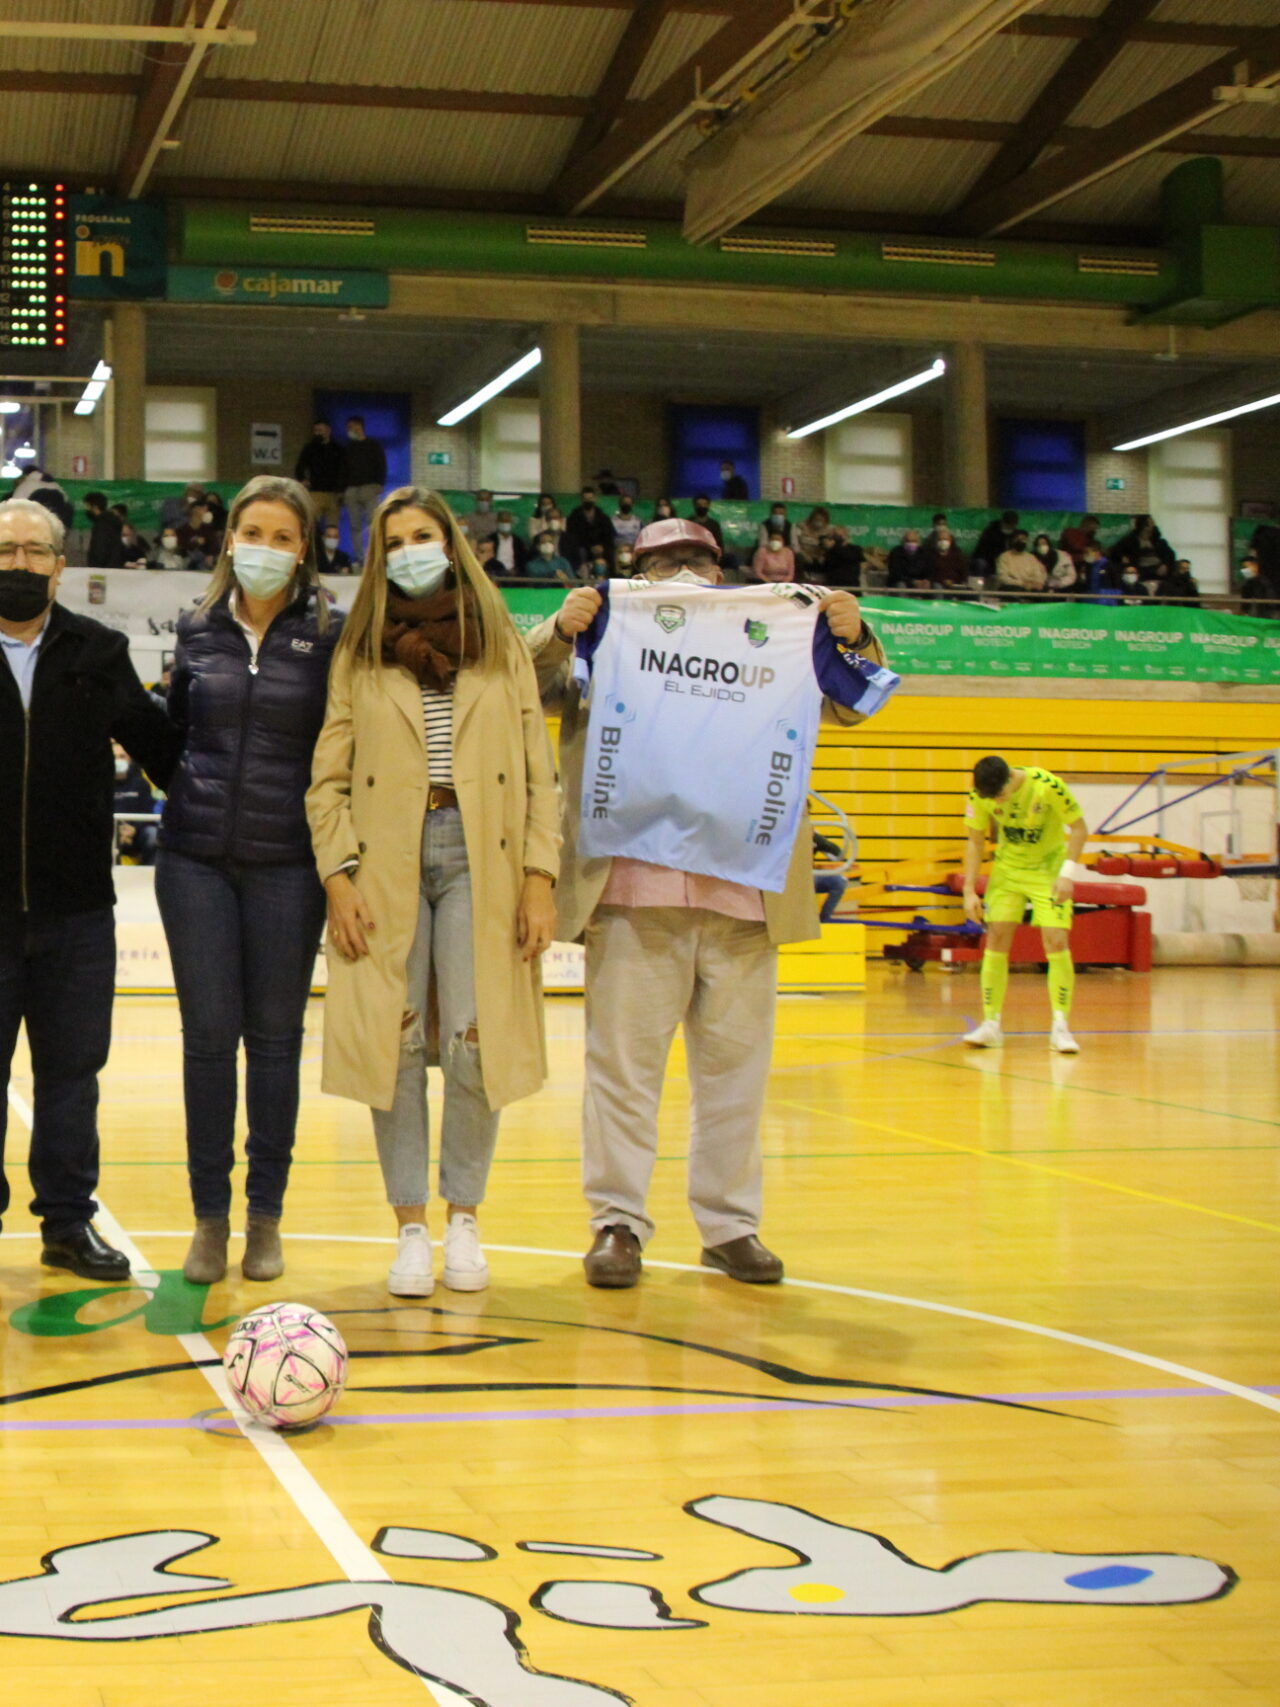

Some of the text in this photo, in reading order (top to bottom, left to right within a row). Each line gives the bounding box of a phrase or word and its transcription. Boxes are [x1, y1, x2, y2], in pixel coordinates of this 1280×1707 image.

[243, 272, 343, 298] cajamar
[882, 623, 953, 636] INAGROUP
[960, 625, 1032, 638] INAGROUP
[1039, 628, 1108, 641] INAGROUP
[1115, 630, 1184, 643] INAGROUP
[291, 638, 314, 652] EA7
[1190, 633, 1258, 647] INAGROUP
[640, 648, 775, 689] INAGROUP
[664, 680, 745, 703] EL EJIDO
[592, 726, 621, 819] Bioline
[755, 751, 793, 846] Bioline
